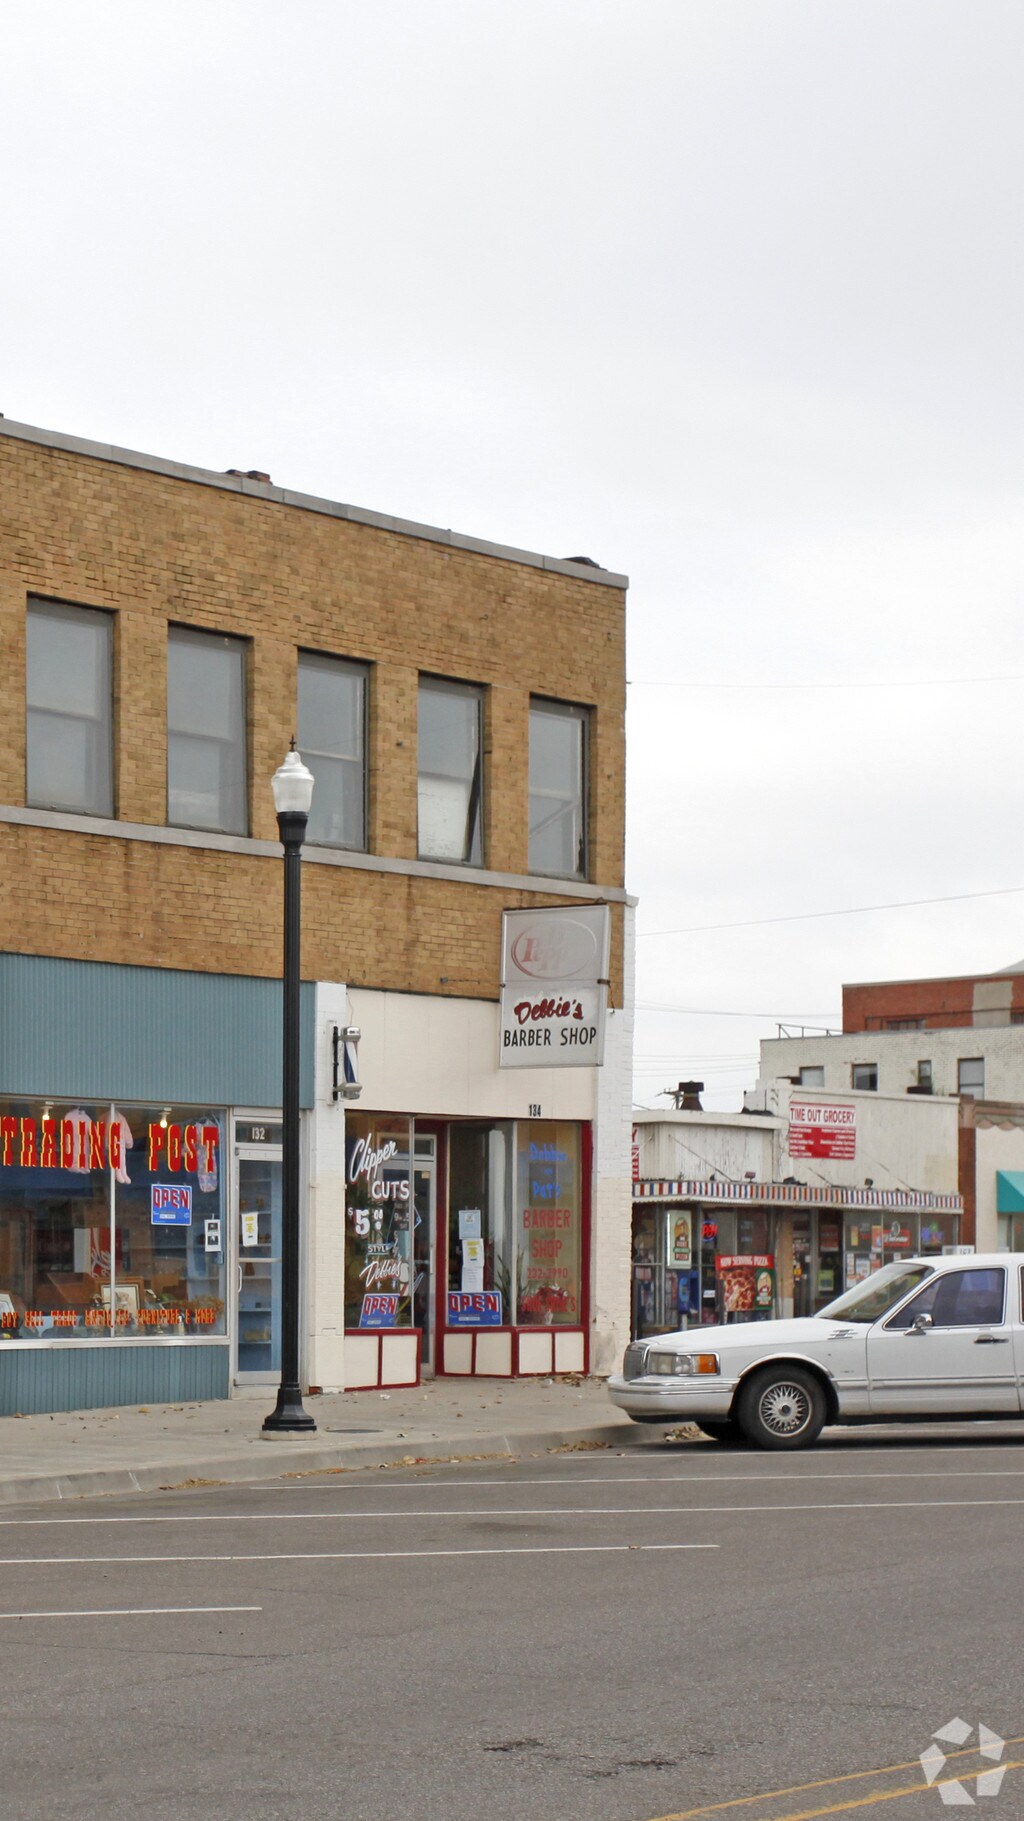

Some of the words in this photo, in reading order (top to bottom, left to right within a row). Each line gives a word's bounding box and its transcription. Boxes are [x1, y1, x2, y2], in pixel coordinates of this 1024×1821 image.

[514, 996, 584, 1025] Debbie's
[504, 1028, 551, 1047] BARBER
[560, 1026, 597, 1046] SHOP
[528, 1104, 541, 1117] 134
[790, 1107, 805, 1121] TIME
[807, 1108, 821, 1122] OUT
[823, 1110, 855, 1124] GROCERY
[251, 1127, 266, 1140] 132
[148, 1123, 219, 1173] POST
[350, 1132, 398, 1182] Clipper
[153, 1187, 190, 1210] OPEN
[371, 1180, 410, 1200] CUTS
[523, 1209, 571, 1229] BARBER
[531, 1239, 563, 1258] SHOP
[754, 1255, 768, 1265] PIZZA
[364, 1296, 398, 1316] OPEN
[449, 1294, 499, 1313] OPEN
[1, 1311, 18, 1328] BUY
[24, 1310, 45, 1327] SELL
[50, 1310, 79, 1327] TRADE
[84, 1308, 130, 1329] ANTIQES
[137, 1308, 181, 1325] FURNITURE
[195, 1308, 216, 1325] MORE
